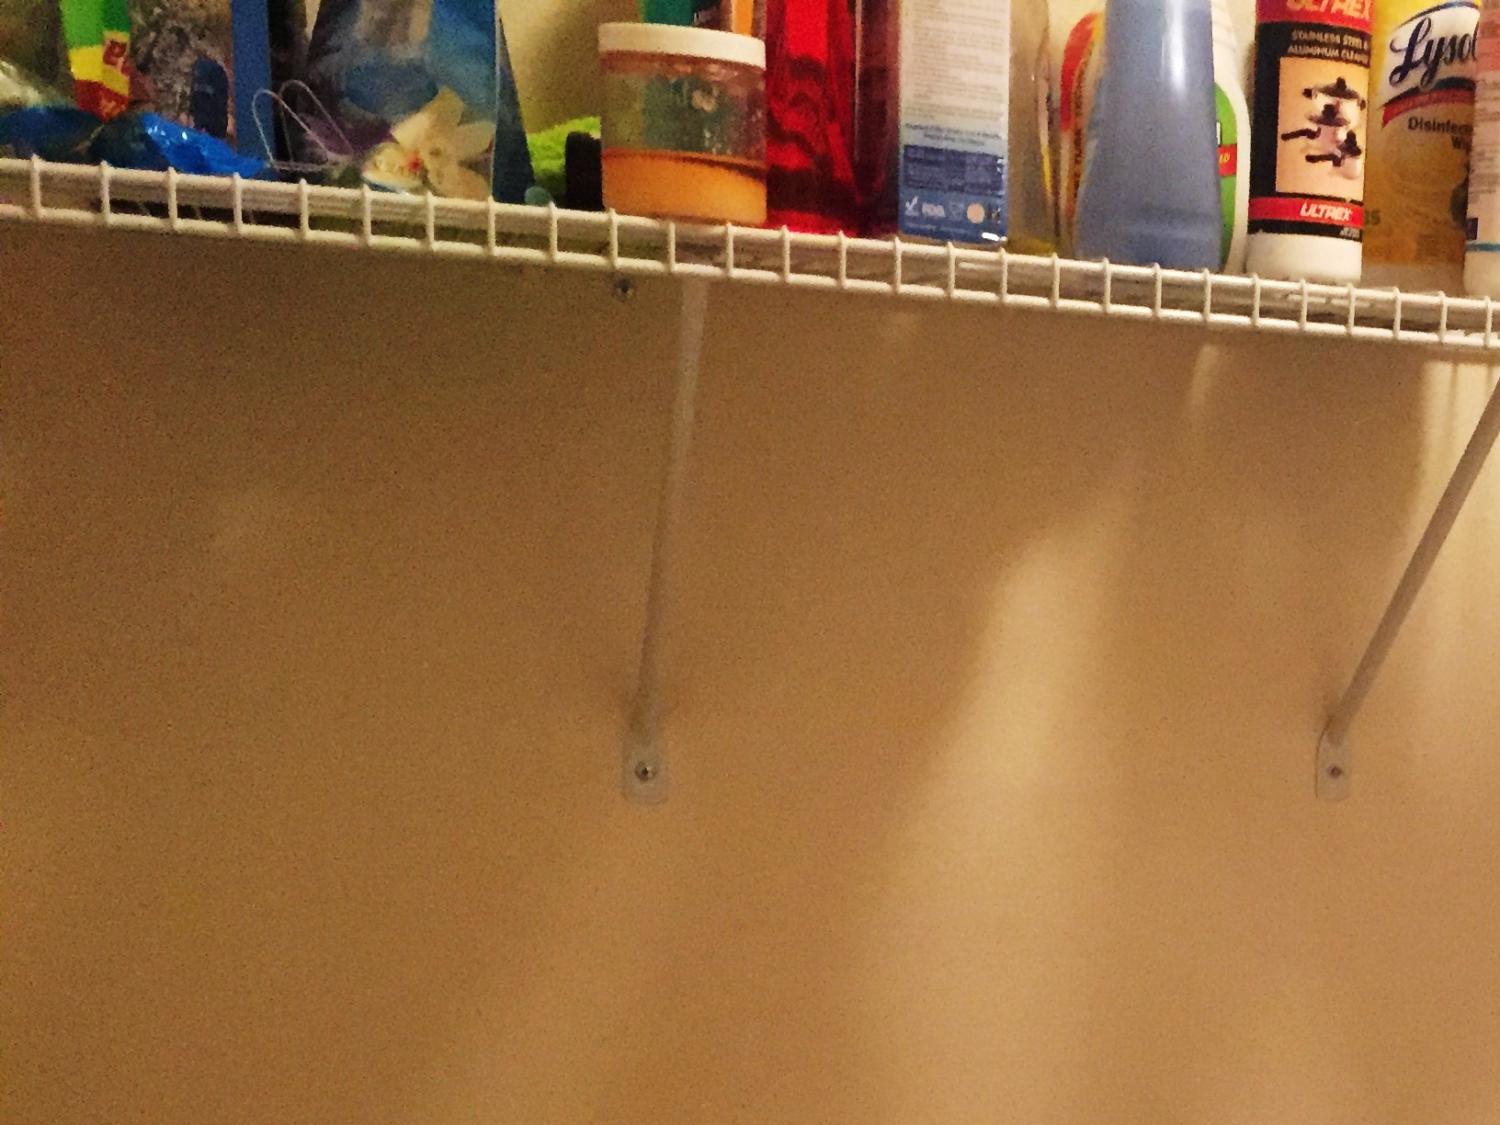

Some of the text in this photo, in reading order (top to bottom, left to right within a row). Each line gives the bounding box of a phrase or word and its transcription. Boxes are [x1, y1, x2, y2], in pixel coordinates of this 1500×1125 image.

[1291, 30, 1341, 43] STAINLESS
[1342, 34, 1362, 49] STEEL
[1287, 44, 1339, 57] ALUMINUM
[1389, 17, 1480, 91] Lysol
[1407, 116, 1474, 135] Disinfec
[1300, 201, 1354, 222] ULTREX
